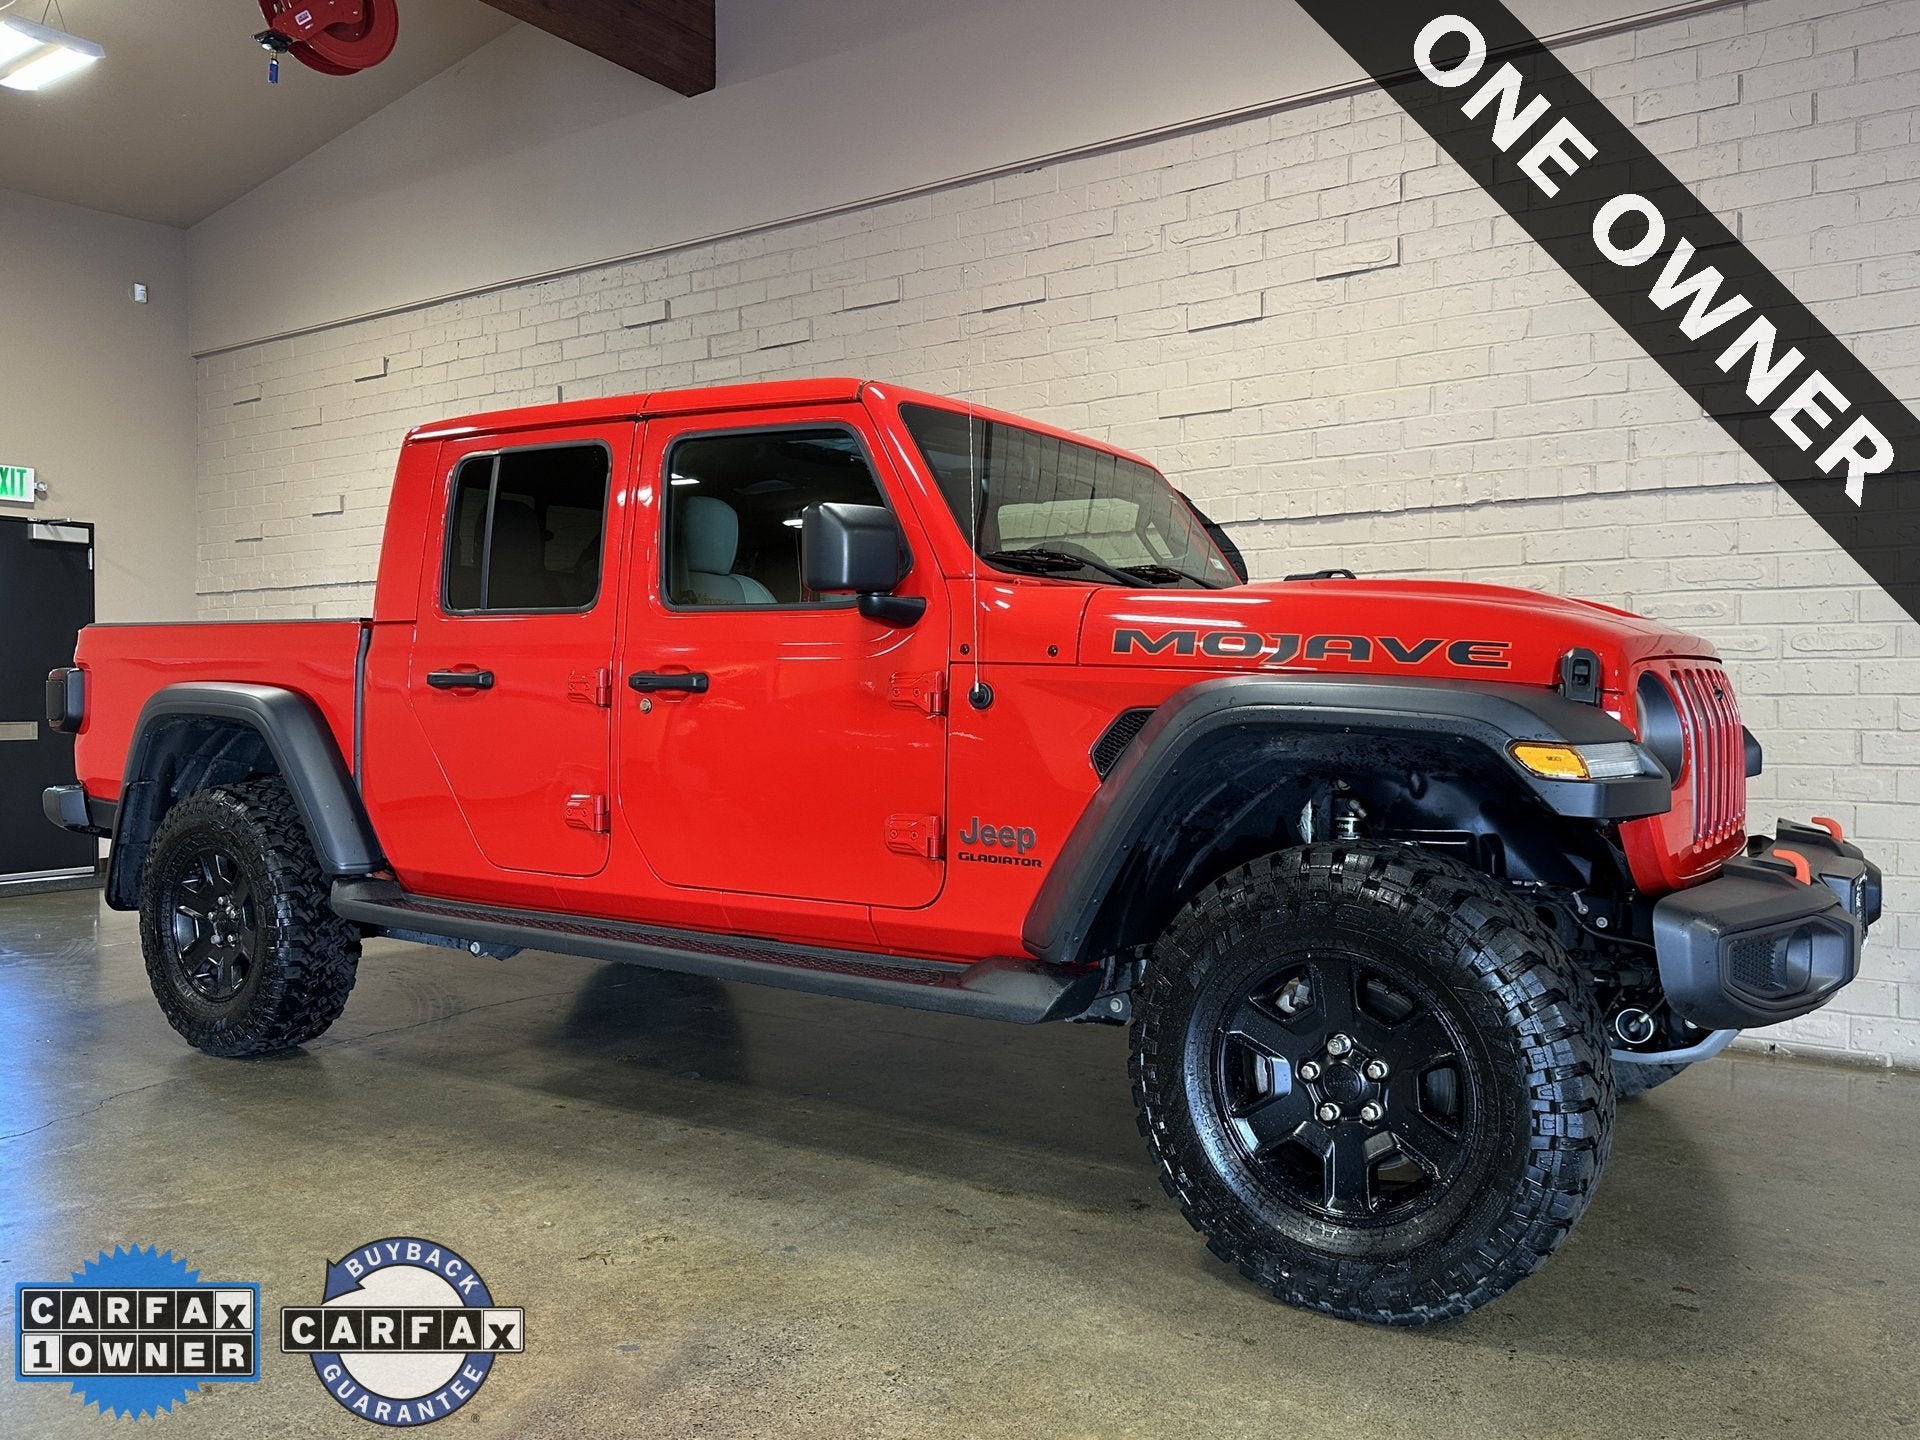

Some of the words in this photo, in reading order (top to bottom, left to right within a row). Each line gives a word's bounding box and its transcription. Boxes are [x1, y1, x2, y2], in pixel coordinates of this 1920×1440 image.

[0, 466, 27, 497] XIT
[1111, 628, 1512, 669] MOJAVE
[960, 816, 1036, 854] Jeep
[957, 852, 1042, 867] GLADIATOR
